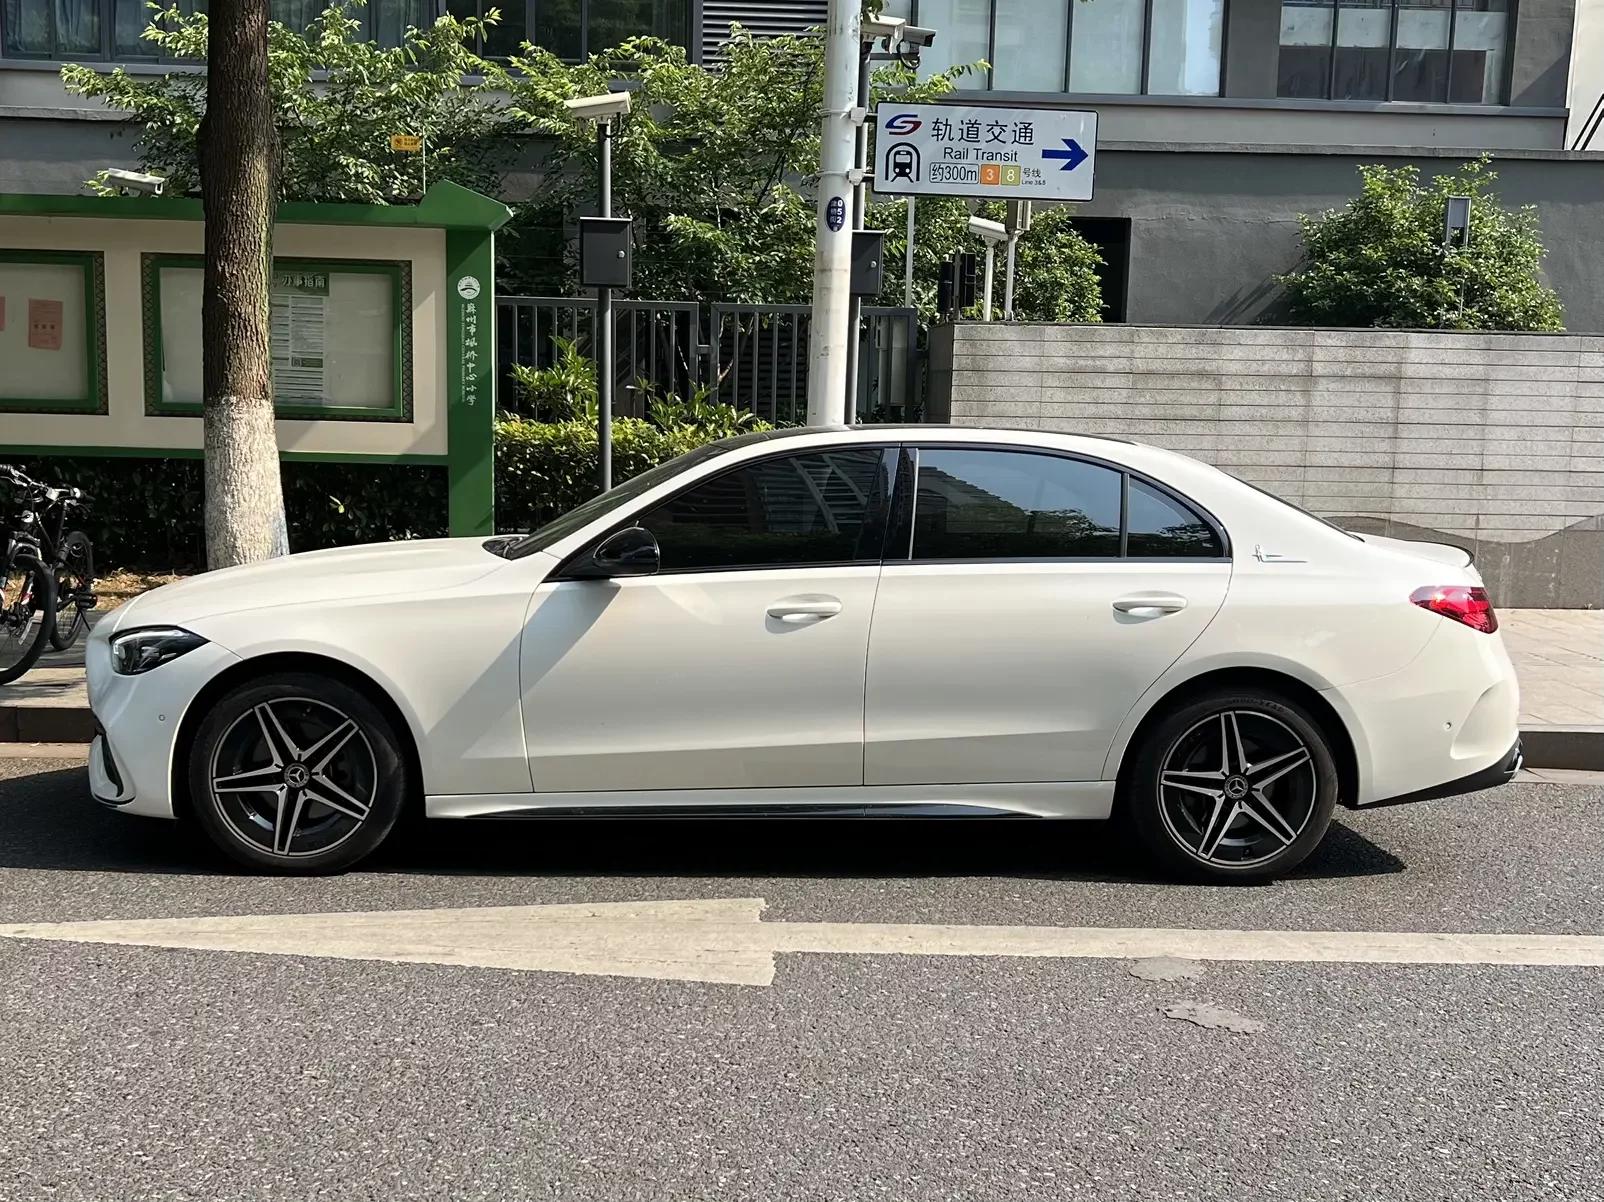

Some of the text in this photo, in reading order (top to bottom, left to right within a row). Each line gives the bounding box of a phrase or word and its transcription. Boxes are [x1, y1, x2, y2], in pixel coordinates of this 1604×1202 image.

[931, 117, 1034, 146] 轨道交通
[943, 147, 1018, 162] Rail Transit
[931, 164, 1041, 182] 约300m 3 8 号线
[835, 199, 843, 224] 052
[279, 273, 325, 288] 办事指南
